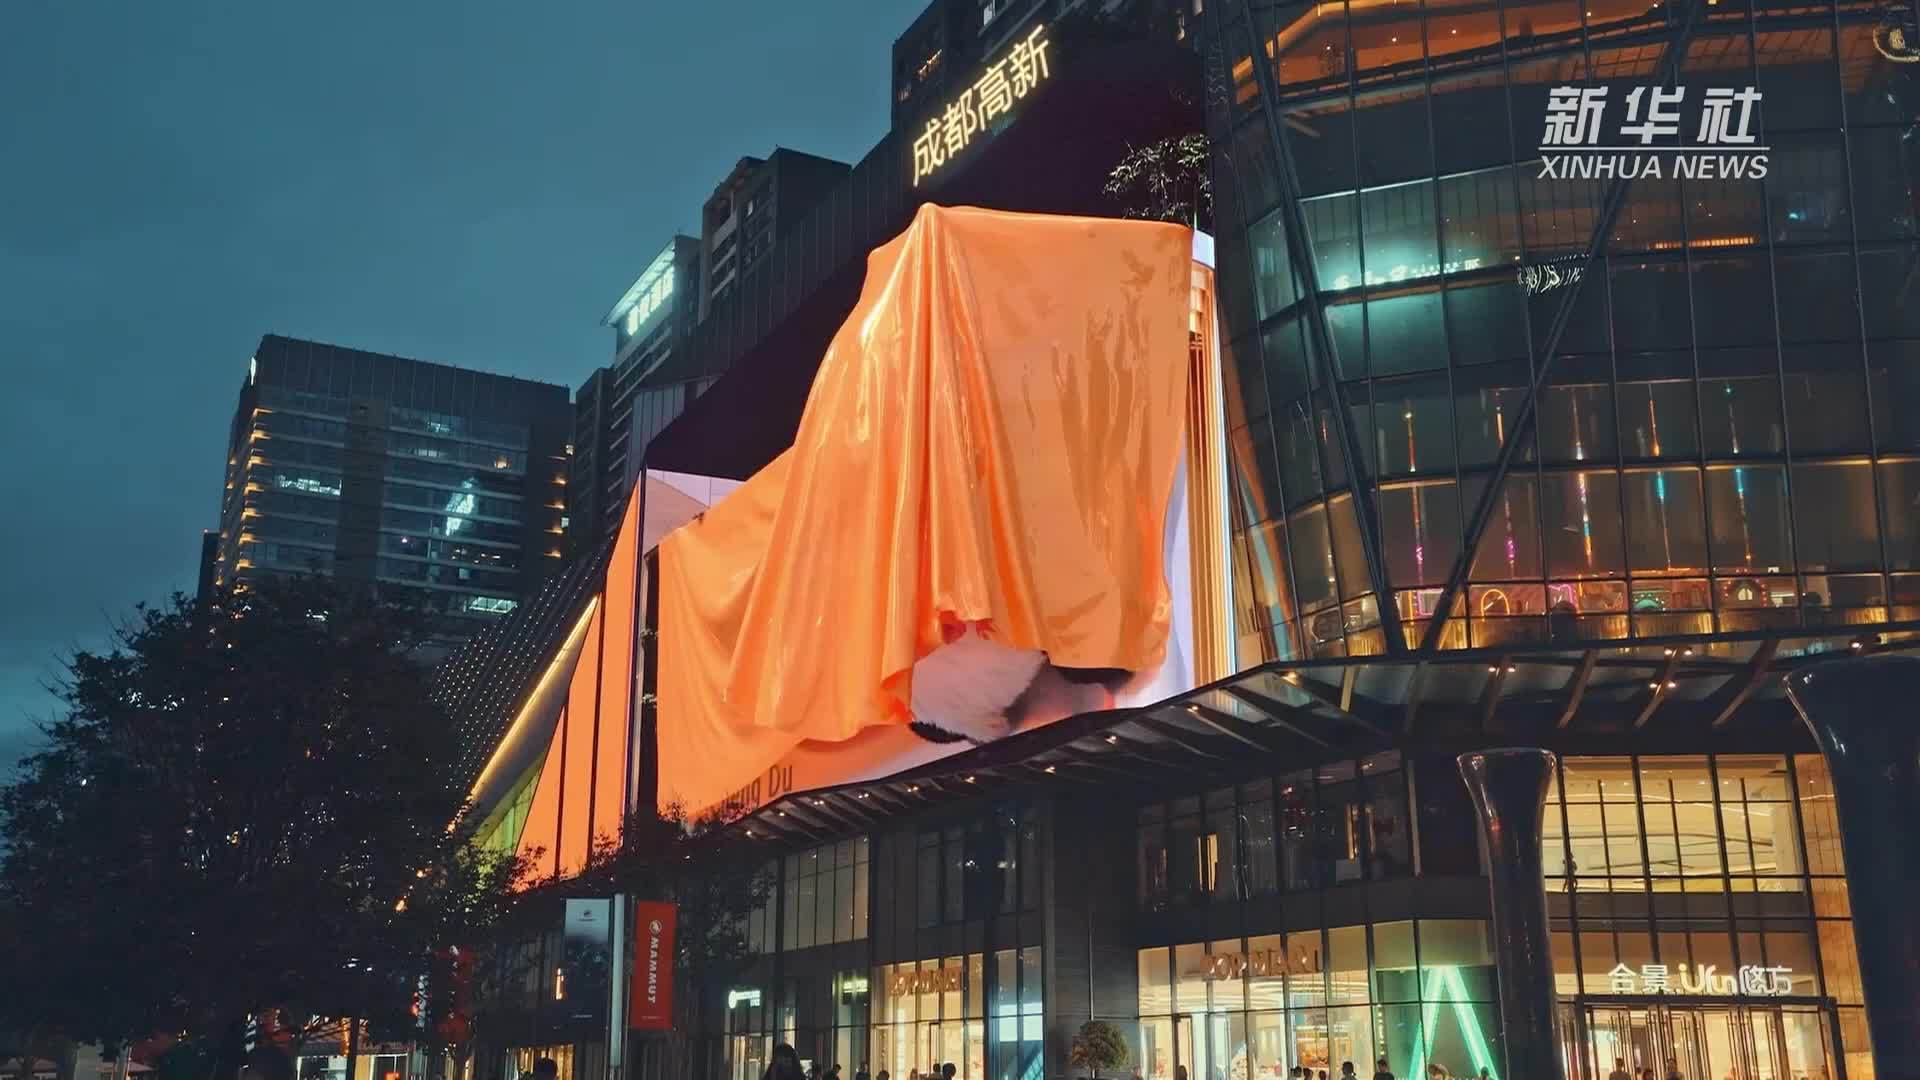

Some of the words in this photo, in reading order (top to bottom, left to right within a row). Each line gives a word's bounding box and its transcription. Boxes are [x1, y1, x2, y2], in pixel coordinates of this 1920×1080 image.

[912, 23, 1049, 187] 成都高新
[768, 764, 793, 798] Du
[647, 937, 659, 1004] MAMMUT
